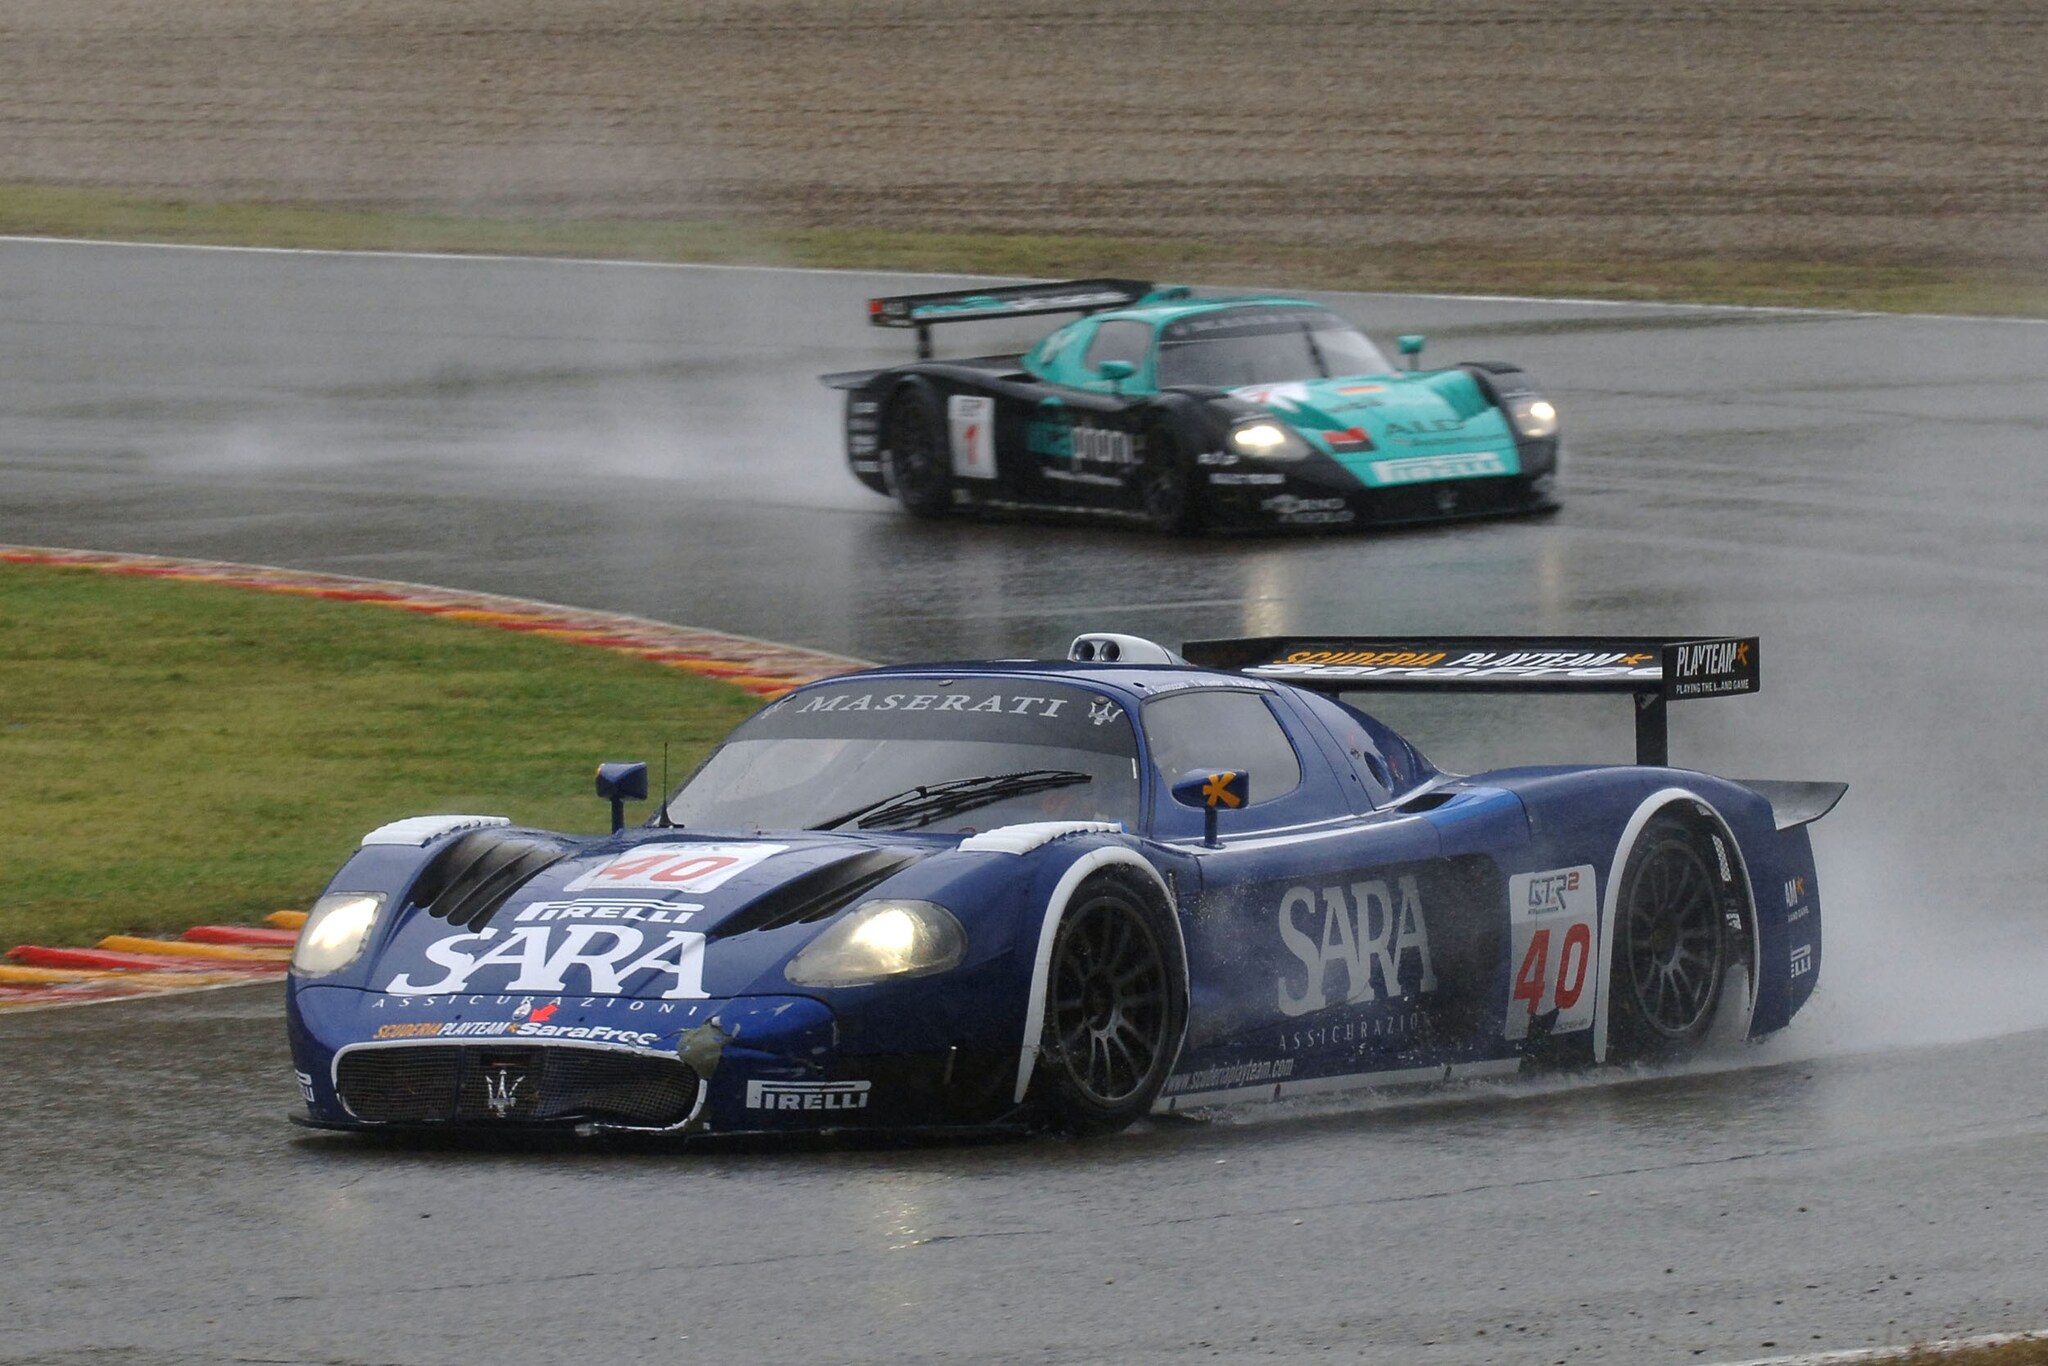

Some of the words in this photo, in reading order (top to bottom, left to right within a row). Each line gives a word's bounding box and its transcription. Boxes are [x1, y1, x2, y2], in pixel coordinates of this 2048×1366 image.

[1272, 651, 1447, 667] SCUDERIA
[1676, 683, 1701, 694] PLAYING
[1701, 682, 1713, 692] THE
[1733, 679, 1750, 690] GAME
[796, 694, 1067, 717] MASERATI
[594, 854, 739, 882] 40
[513, 898, 705, 924] PIRELLI
[1277, 874, 1438, 1017] SARA
[385, 924, 712, 1000] SARA
[1513, 922, 1590, 1016] 40
[372, 994, 698, 1016] ASSICURAZIONI
[372, 1022, 445, 1040] SCUDERIA
[1166, 1057, 1295, 1093] www.scuderiaplayteam.com
[746, 1079, 872, 1110] PIRELLI
